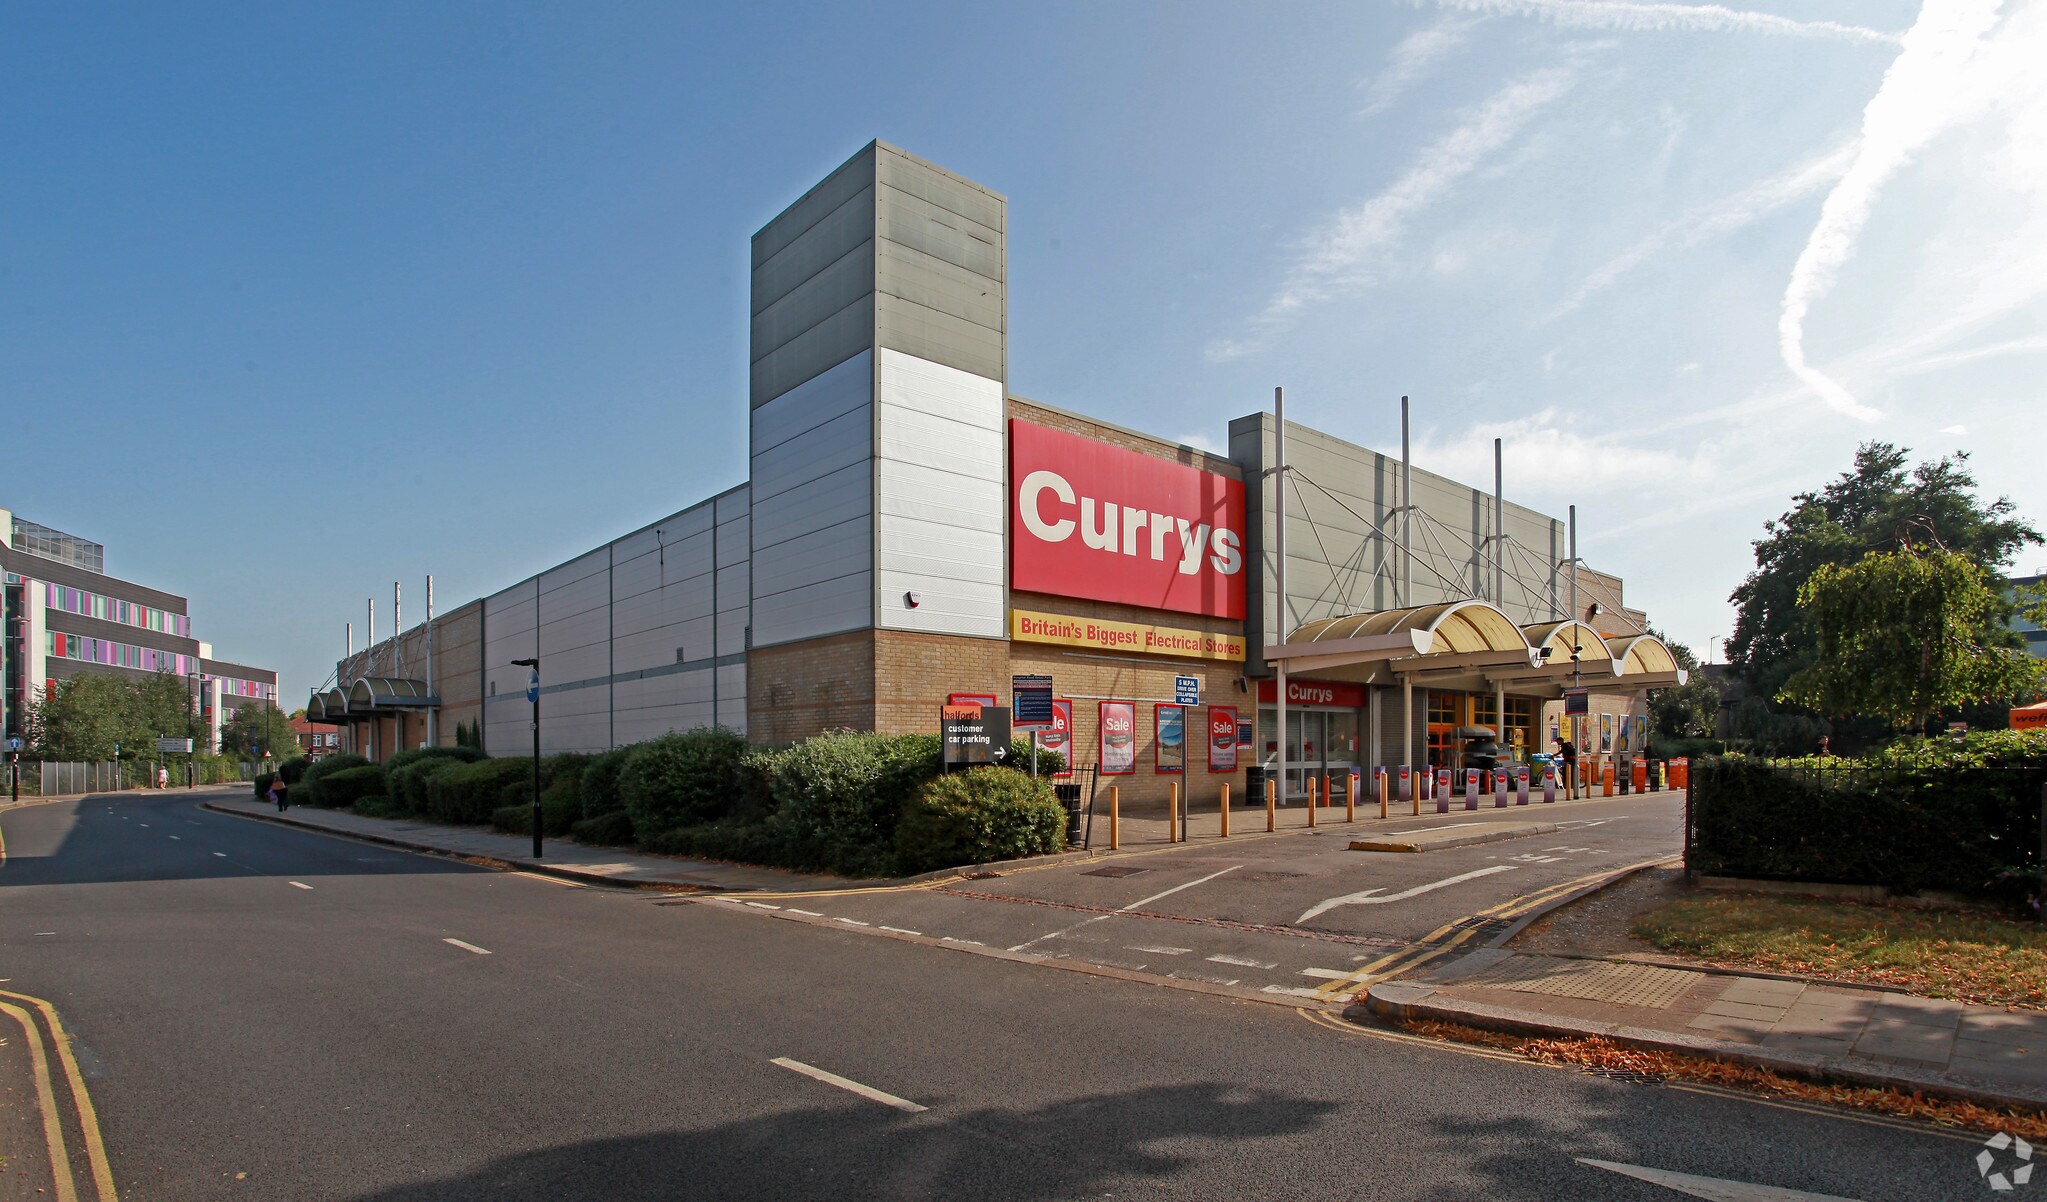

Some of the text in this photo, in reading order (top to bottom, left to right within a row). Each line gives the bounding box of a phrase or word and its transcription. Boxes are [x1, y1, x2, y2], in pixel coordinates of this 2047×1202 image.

[1019, 470, 1242, 575] Currys
[1021, 617, 1241, 655] Britain's Biggest Electrical Stores
[1288, 683, 1333, 703] Currys
[944, 710, 980, 720] halfords
[948, 724, 984, 733] customer
[1053, 715, 1065, 730] le
[1106, 717, 1130, 731] Sale
[1213, 721, 1233, 734] Sale
[962, 734, 991, 745] parking
